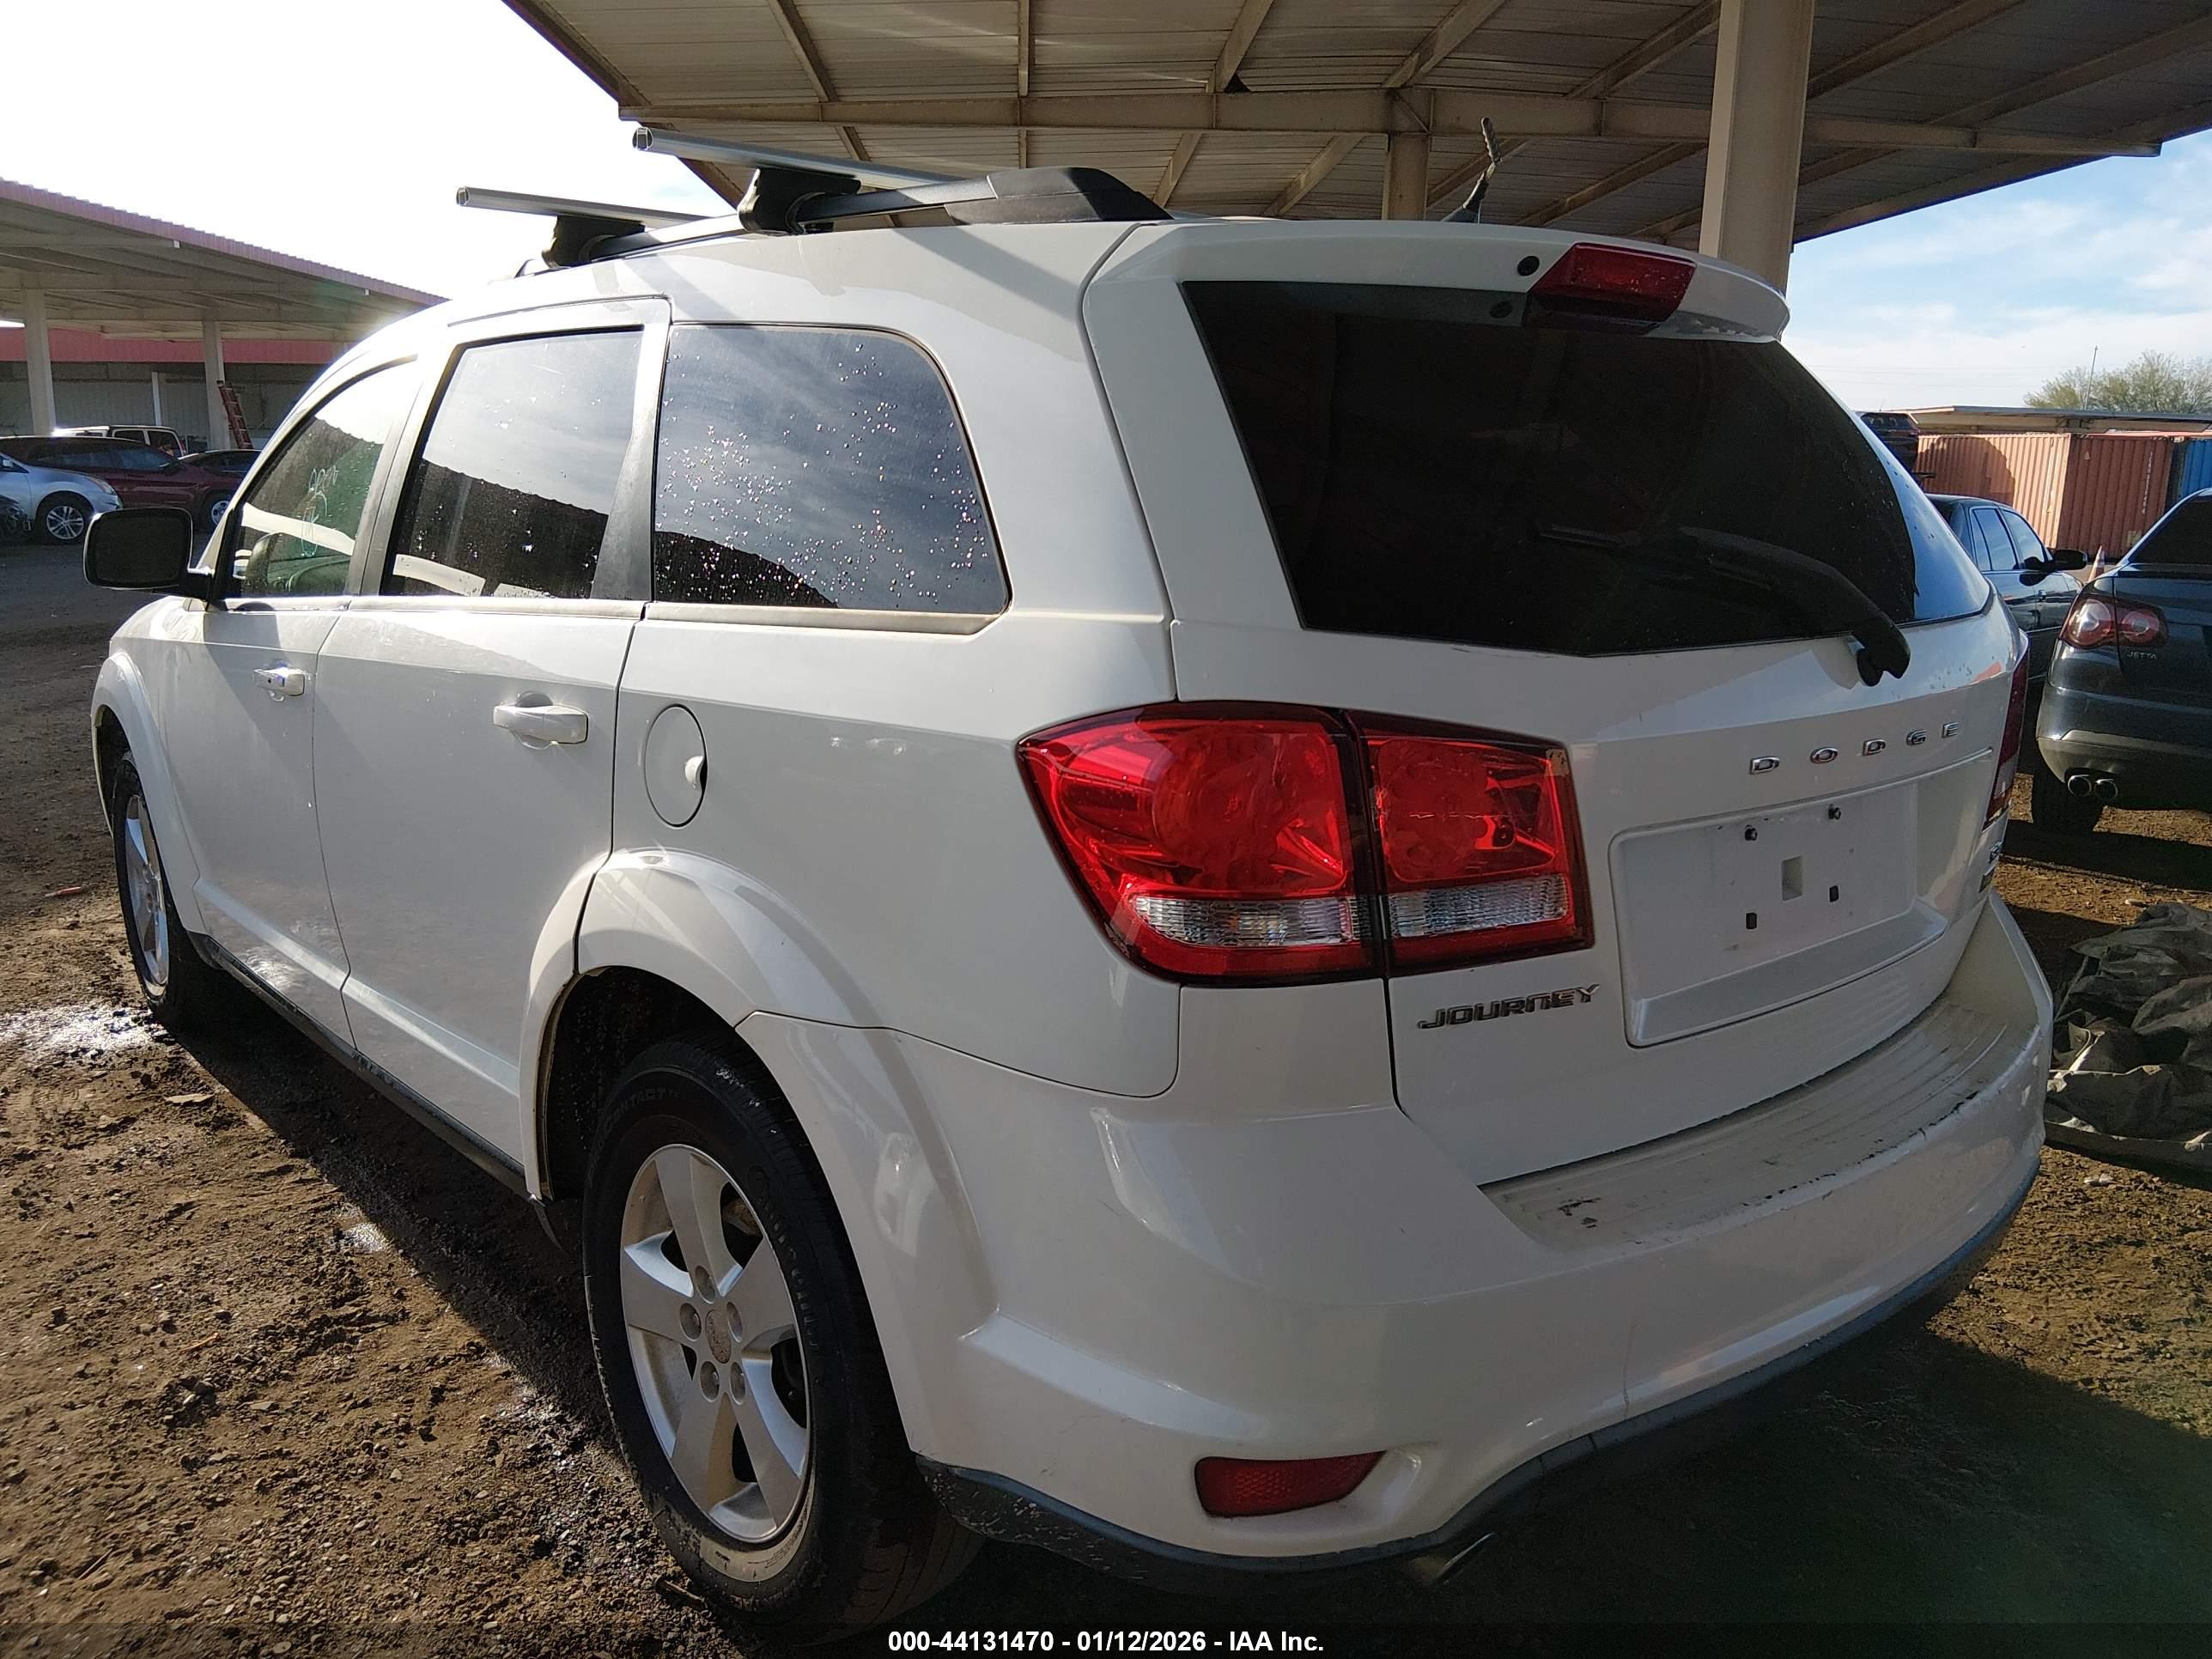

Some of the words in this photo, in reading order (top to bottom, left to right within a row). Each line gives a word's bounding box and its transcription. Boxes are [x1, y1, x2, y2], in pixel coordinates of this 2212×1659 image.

[2125, 651, 2157, 660] JETTA
[1749, 721, 1959, 775] DODGE
[1417, 982, 1601, 1030] JOURNEY
